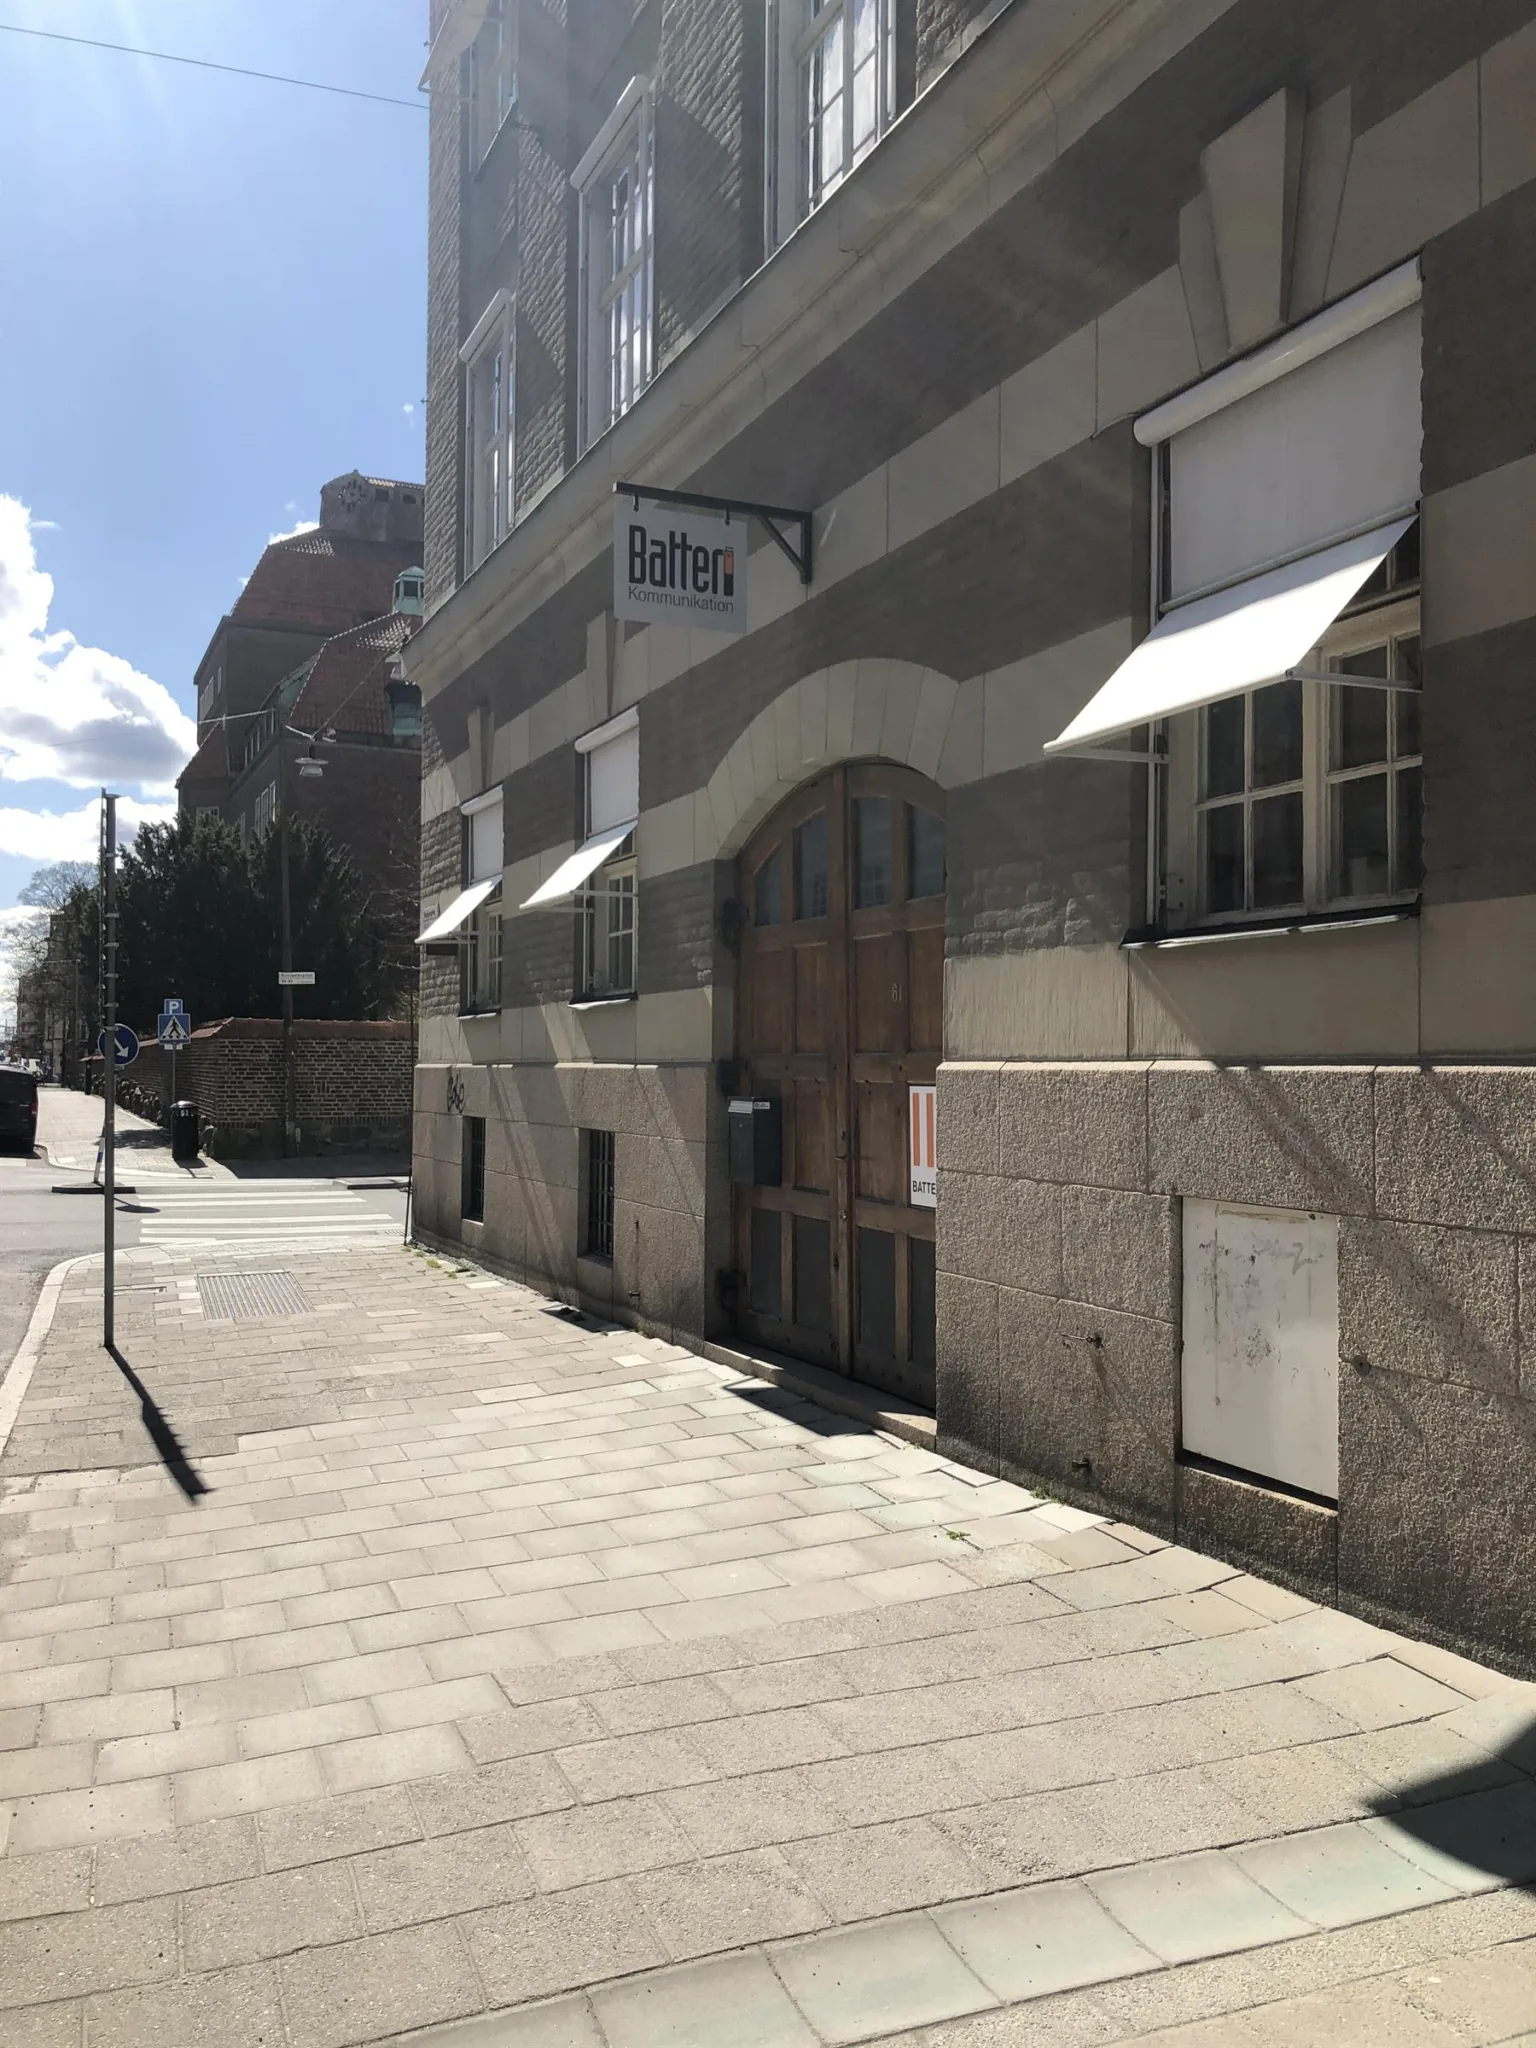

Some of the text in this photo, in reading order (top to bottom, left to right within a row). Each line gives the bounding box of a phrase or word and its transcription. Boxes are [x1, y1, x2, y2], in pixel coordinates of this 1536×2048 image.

[628, 524, 735, 597] Batteri
[628, 585, 734, 613] Kommunikation
[892, 982, 902, 1002] 61
[169, 1001, 180, 1014] P
[912, 1180, 936, 1195] BATTE
